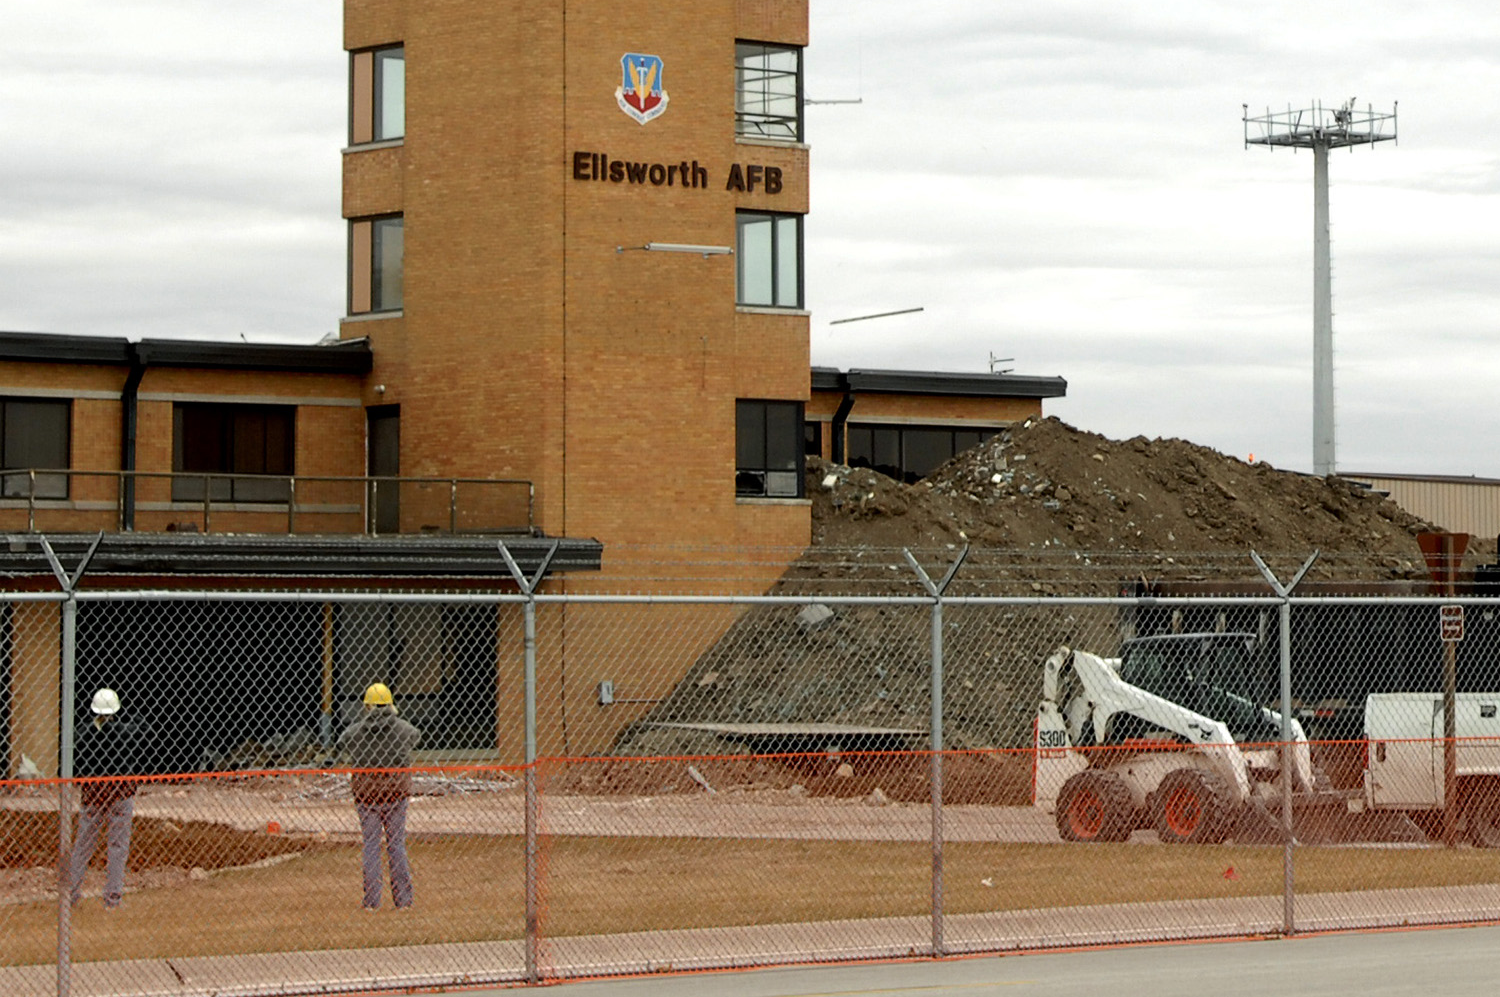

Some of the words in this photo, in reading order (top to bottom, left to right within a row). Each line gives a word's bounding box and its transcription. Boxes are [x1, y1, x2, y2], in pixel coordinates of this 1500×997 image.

[573, 151, 708, 189] Ellsworth
[726, 163, 783, 194] AFB
[1039, 730, 1066, 747] S300
